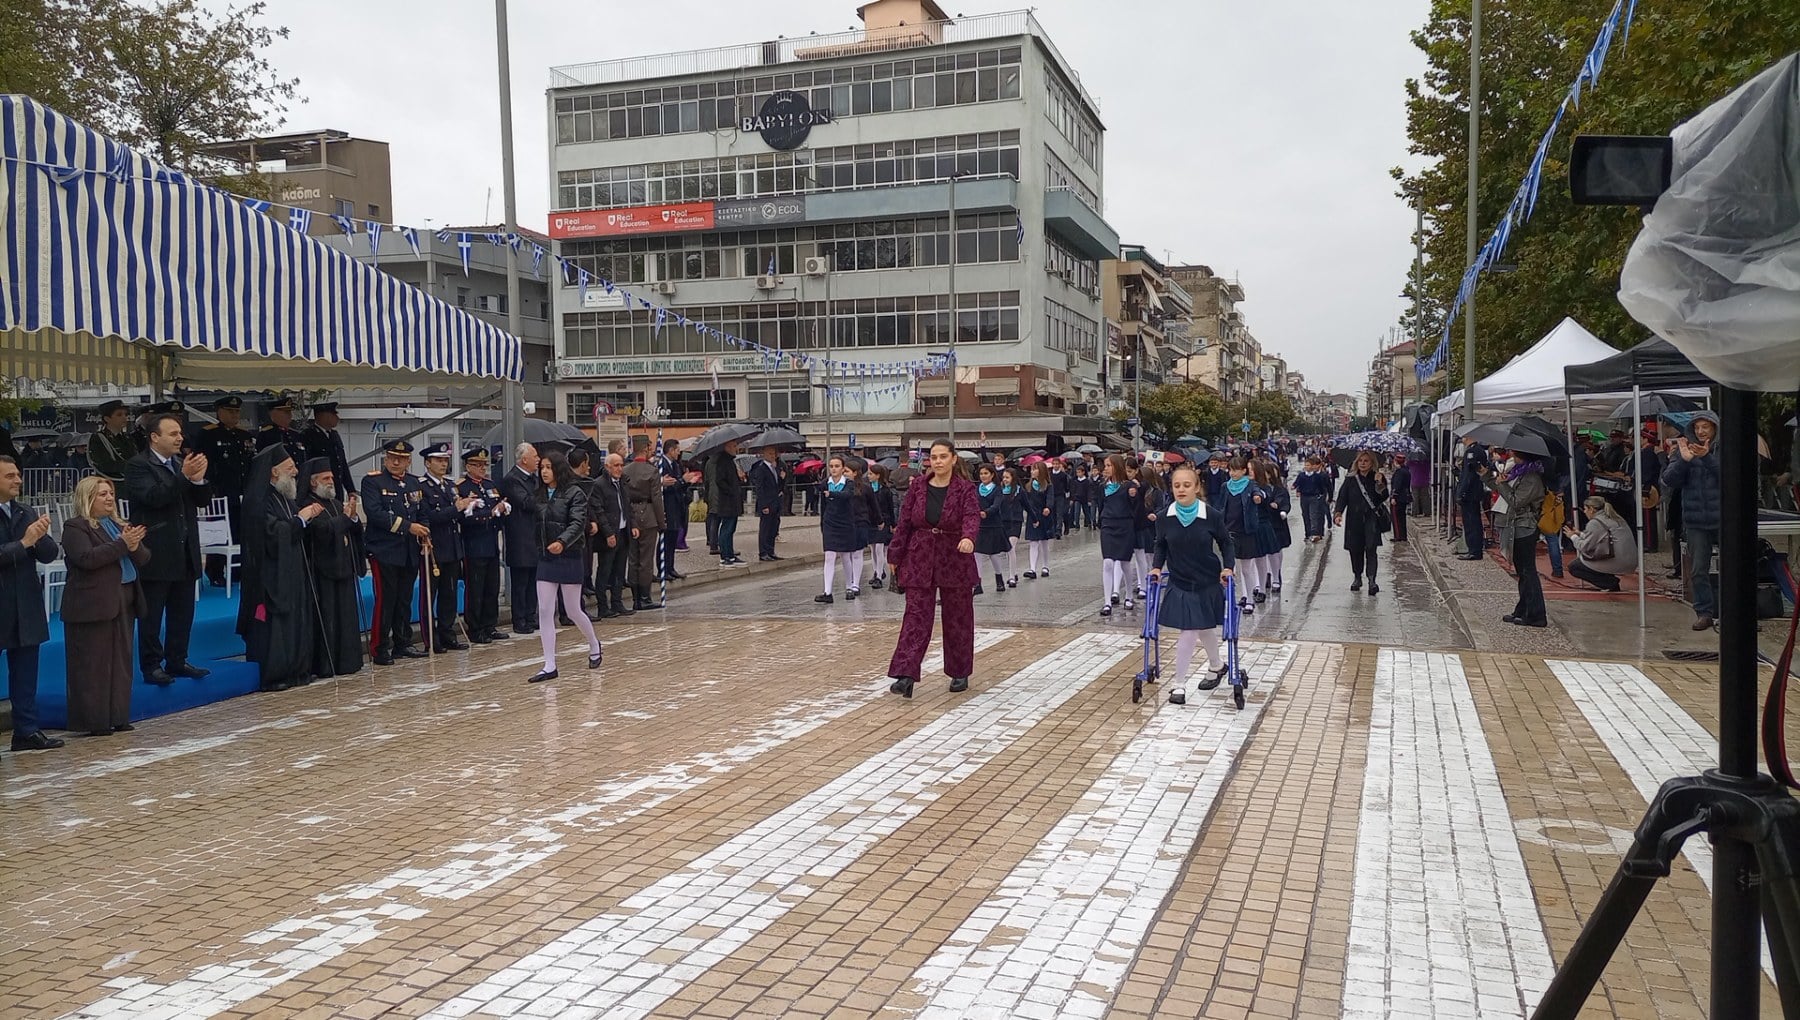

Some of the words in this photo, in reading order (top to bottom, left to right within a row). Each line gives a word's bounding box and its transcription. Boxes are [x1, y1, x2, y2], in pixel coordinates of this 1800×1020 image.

[742, 109, 829, 132] BABYLON
[670, 210, 687, 218] Real
[778, 205, 802, 215] ECDL
[616, 214, 633, 222] Real
[674, 216, 704, 224] Education
[567, 224, 596, 232] Education
[620, 220, 650, 228] Education
[641, 406, 672, 416] coffee
